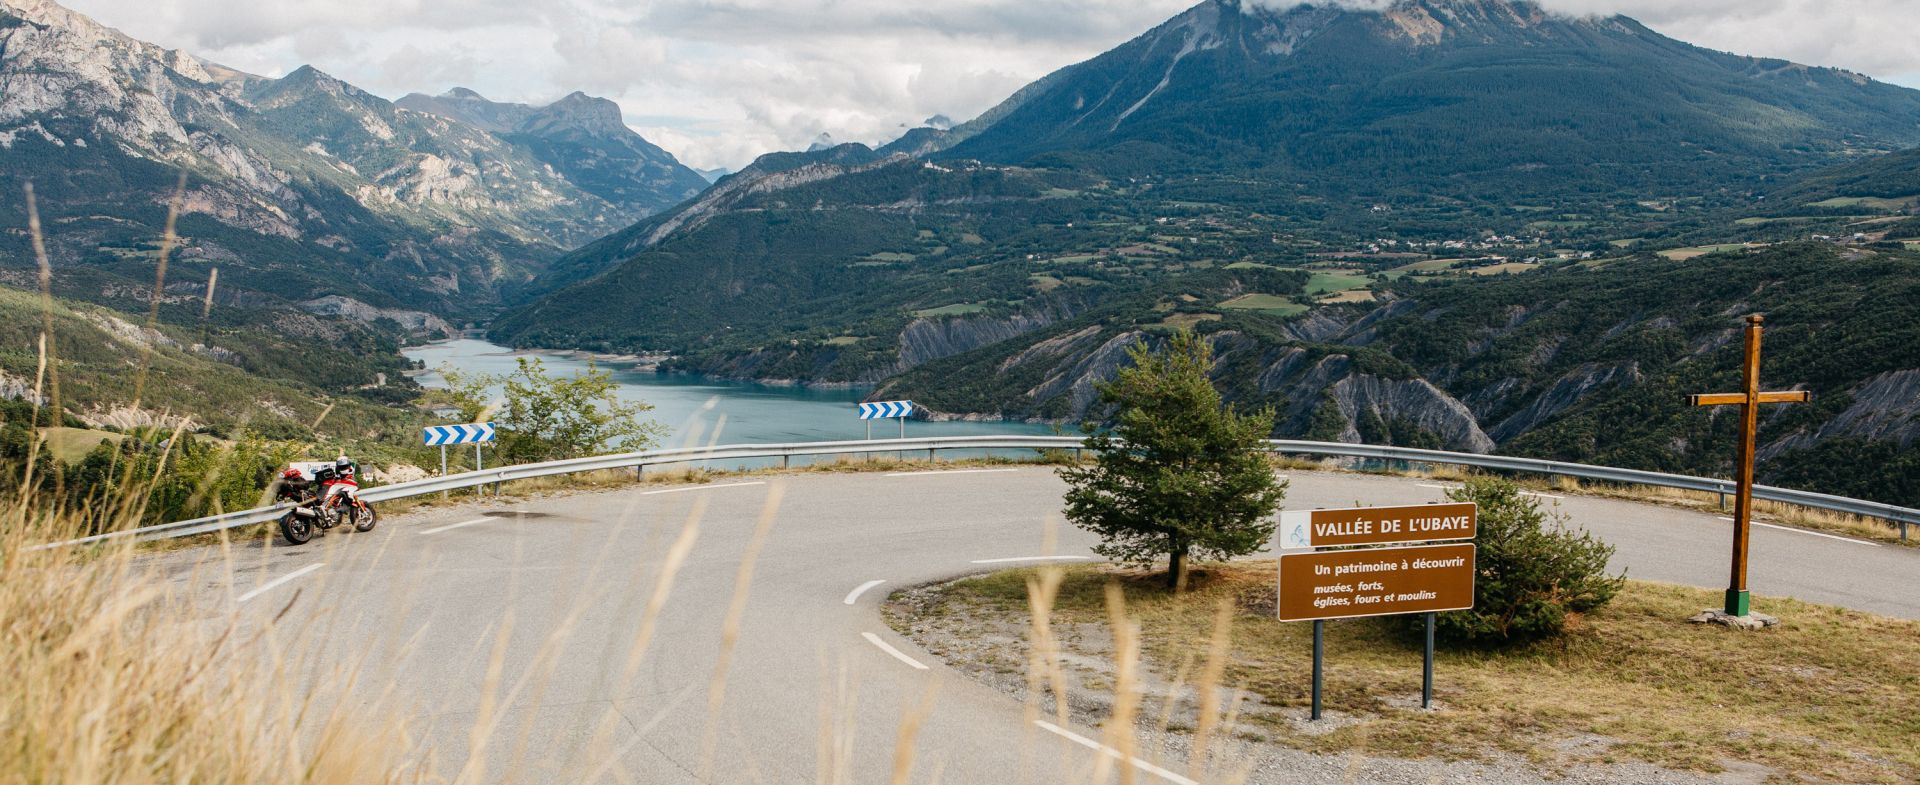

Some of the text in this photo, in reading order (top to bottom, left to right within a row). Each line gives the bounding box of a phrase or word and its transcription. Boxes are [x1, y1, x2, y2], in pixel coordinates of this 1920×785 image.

[1314, 516, 1469, 537] VALLÉE DE L'UBAYE
[1314, 556, 1465, 576] Un patrimoine à découvrir
[1313, 581, 1385, 594] musées, forts,
[1313, 590, 1437, 609] églises, fours et moulins
